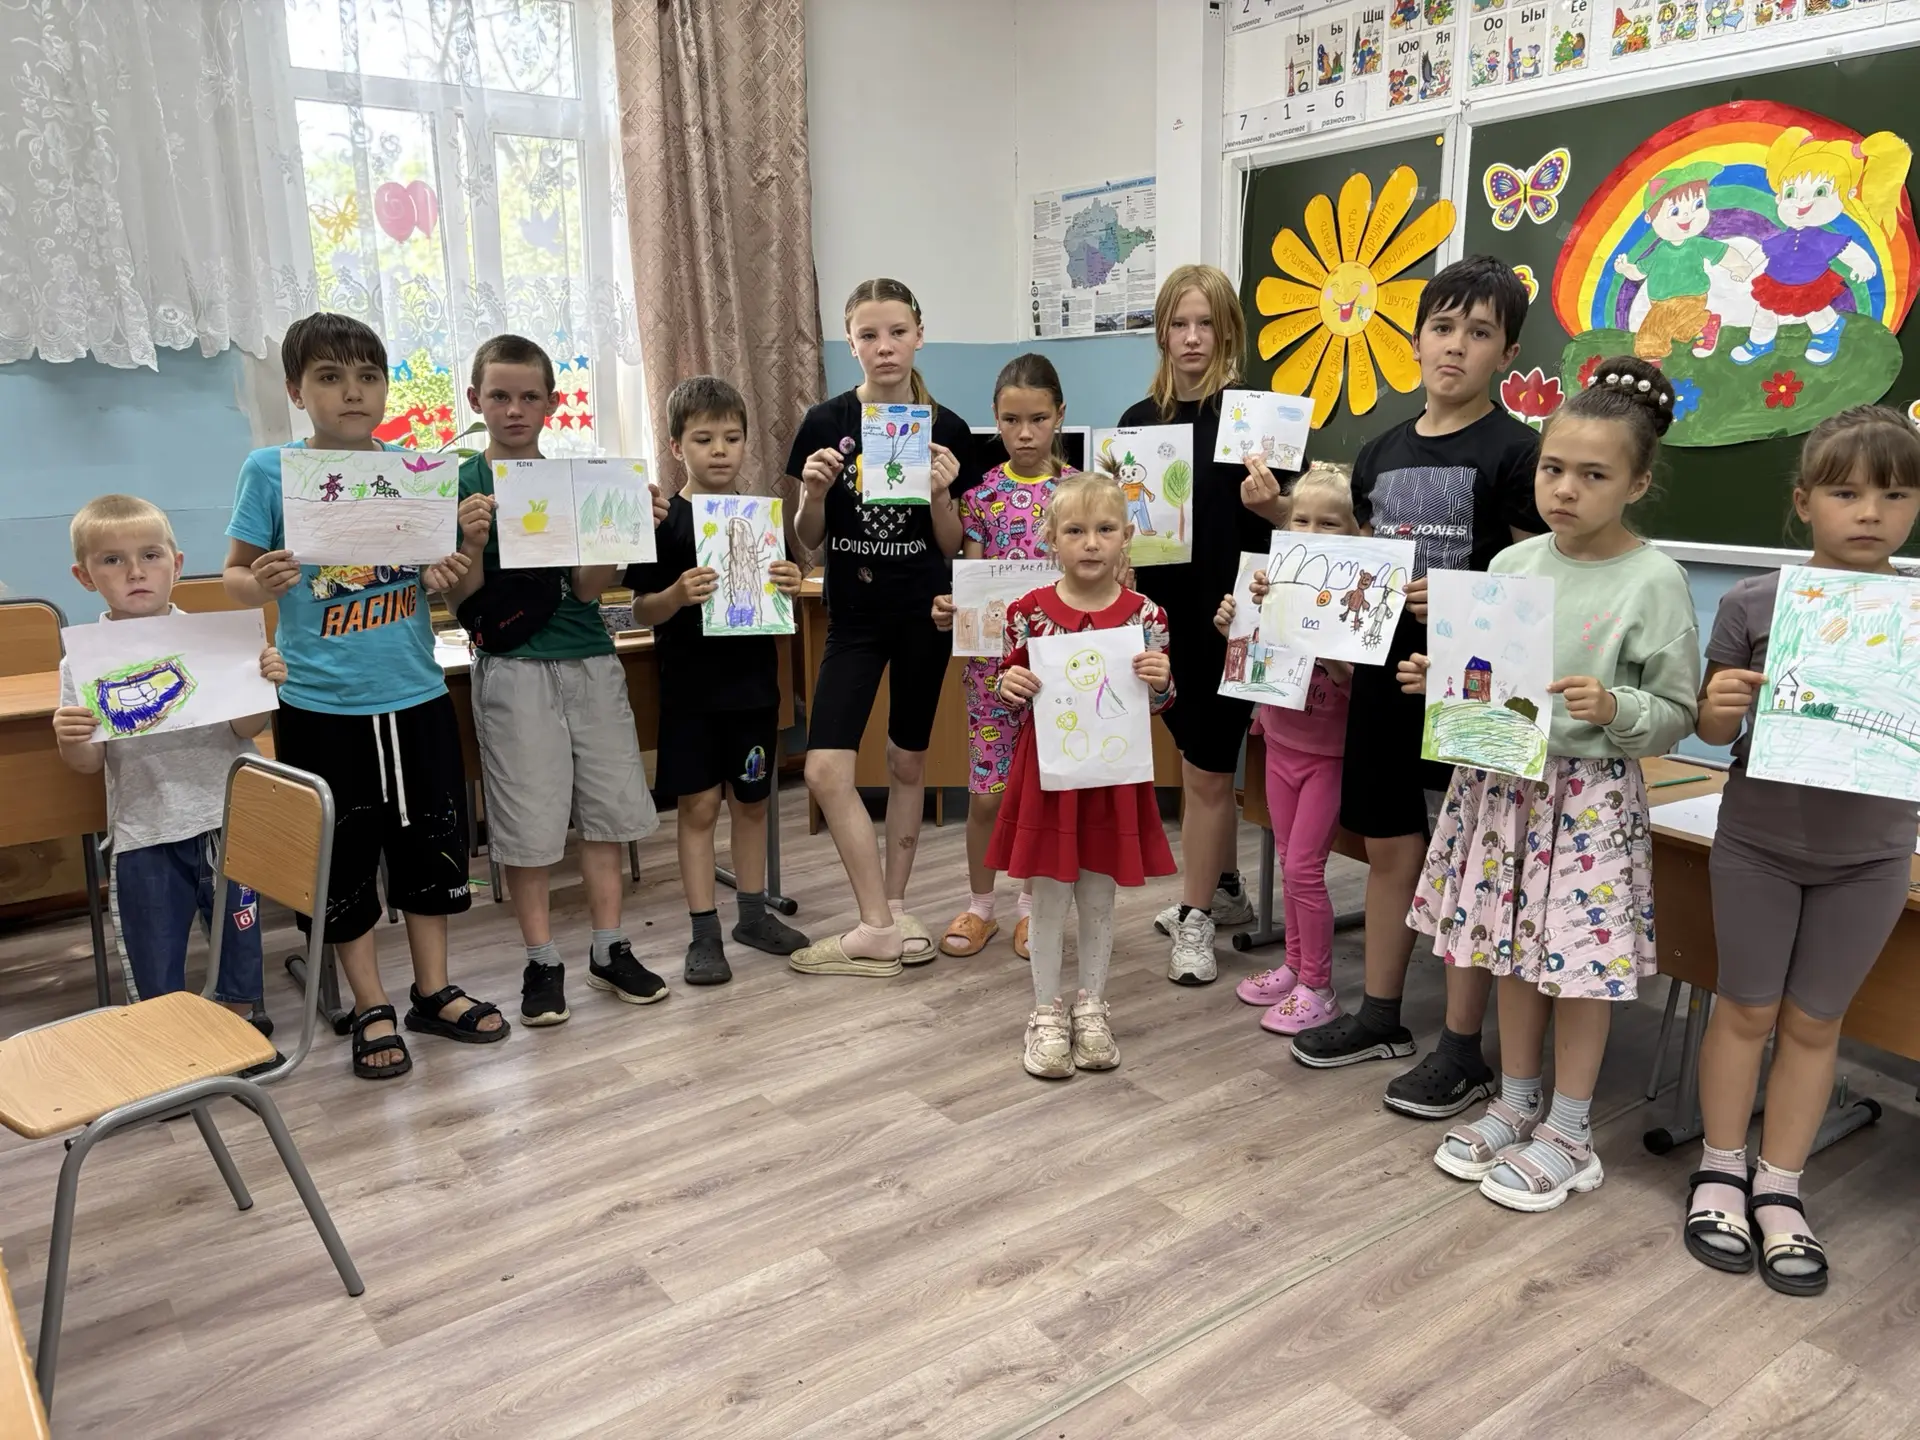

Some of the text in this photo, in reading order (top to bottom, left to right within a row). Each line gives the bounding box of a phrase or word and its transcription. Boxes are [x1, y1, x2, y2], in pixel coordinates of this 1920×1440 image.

[1483, 17, 1503, 32] Оо
[1521, 8, 1546, 24] Ыы
[1397, 40, 1420, 56] Юю
[1435, 31, 1451, 46] Яя
[1239, 114, 1248, 131] 7
[1283, 103, 1291, 120] 1
[1334, 90, 1344, 108] 6
[1320, 220, 1336, 259] ИГРАТЬ
[1347, 208, 1358, 253] ИСКАТЬ
[1364, 201, 1395, 256] ДРУЖИТЬ
[1377, 231, 1427, 277] СОЧИНЯТЬ
[1371, 323, 1406, 364] ПРОЩАТЬ
[1352, 339, 1370, 390] МЕЧТАТЬ
[1412, 523, 1468, 536] JONES
[989, 564, 1013, 578] ТРИ
[320, 584, 417, 639] RACING
[239, 912, 251, 926] 6
[1553, 1137, 1577, 1152] SPORT
